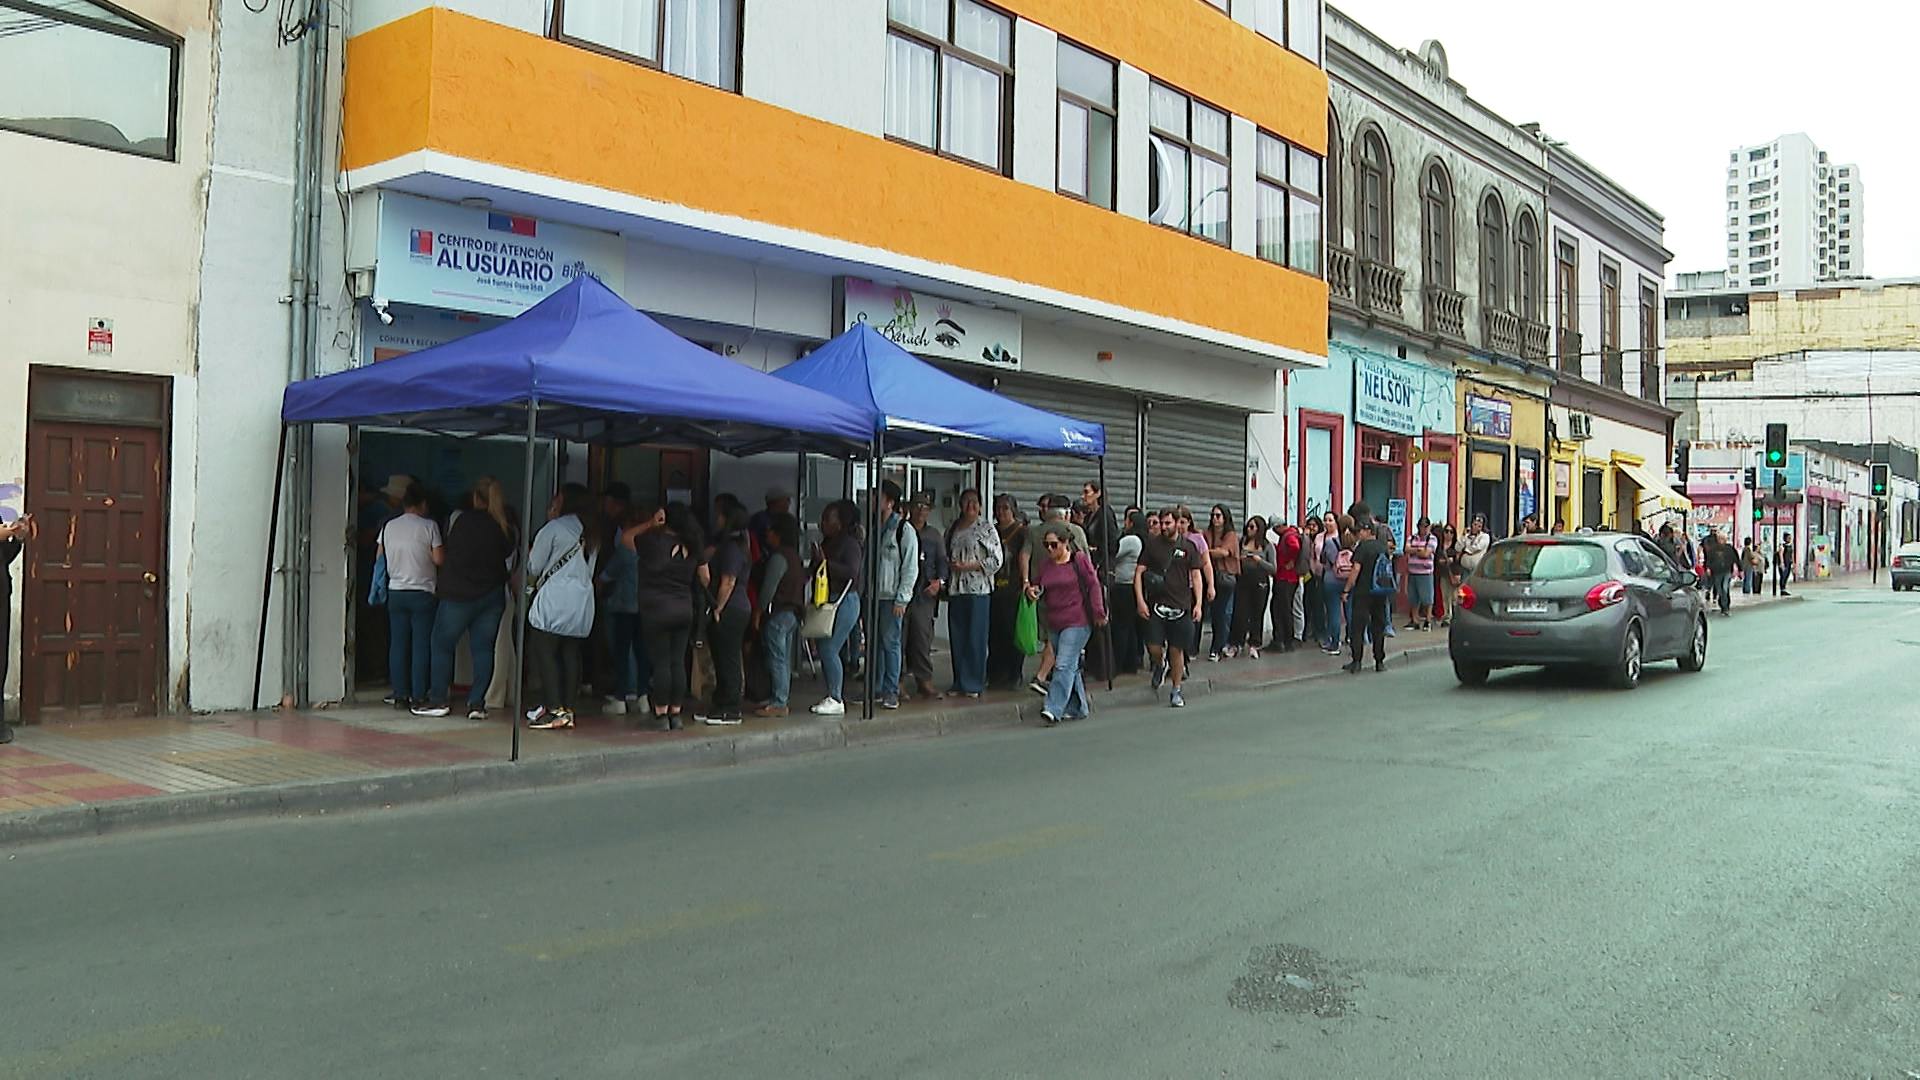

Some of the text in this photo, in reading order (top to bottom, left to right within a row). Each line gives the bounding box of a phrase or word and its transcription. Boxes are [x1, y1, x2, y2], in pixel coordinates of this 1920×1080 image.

[437, 233, 554, 262] CENTRO DE ATENCIÓN
[437, 248, 463, 270] AL
[466, 251, 554, 282] USUARIO
[882, 319, 930, 346] Baruch
